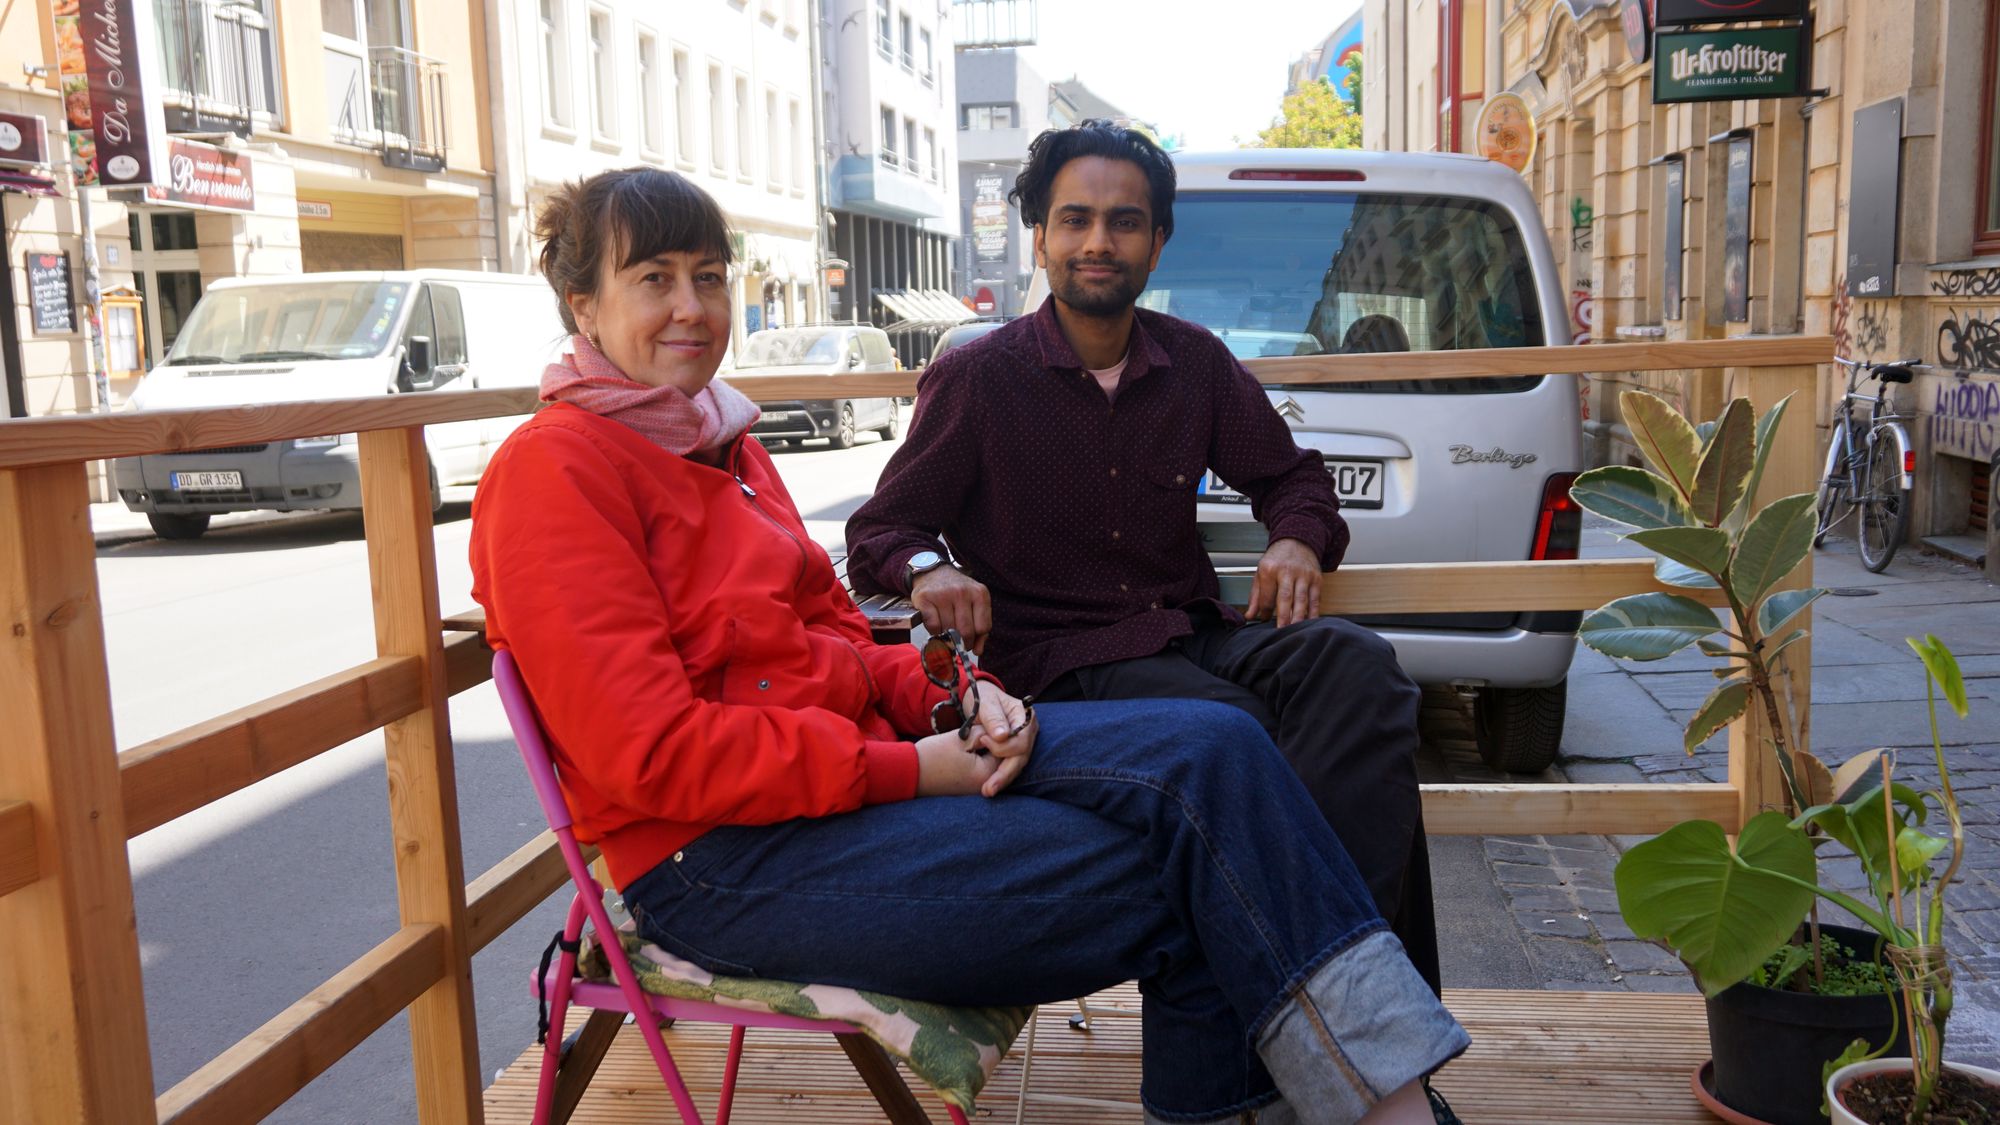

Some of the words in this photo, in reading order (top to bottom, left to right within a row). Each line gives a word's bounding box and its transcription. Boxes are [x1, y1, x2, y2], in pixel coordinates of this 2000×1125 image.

[1686, 77, 1738, 87] FEINHERBES
[1741, 75, 1774, 84] PILSNER
[103, 97, 131, 145] Da
[172, 154, 252, 200] Benvenuto
[976, 177, 1003, 187] LUNCH
[1448, 444, 1537, 469] Berlingo
[178, 473, 193, 486] DD
[199, 473, 213, 486] GR
[213, 473, 240, 486] 1351
